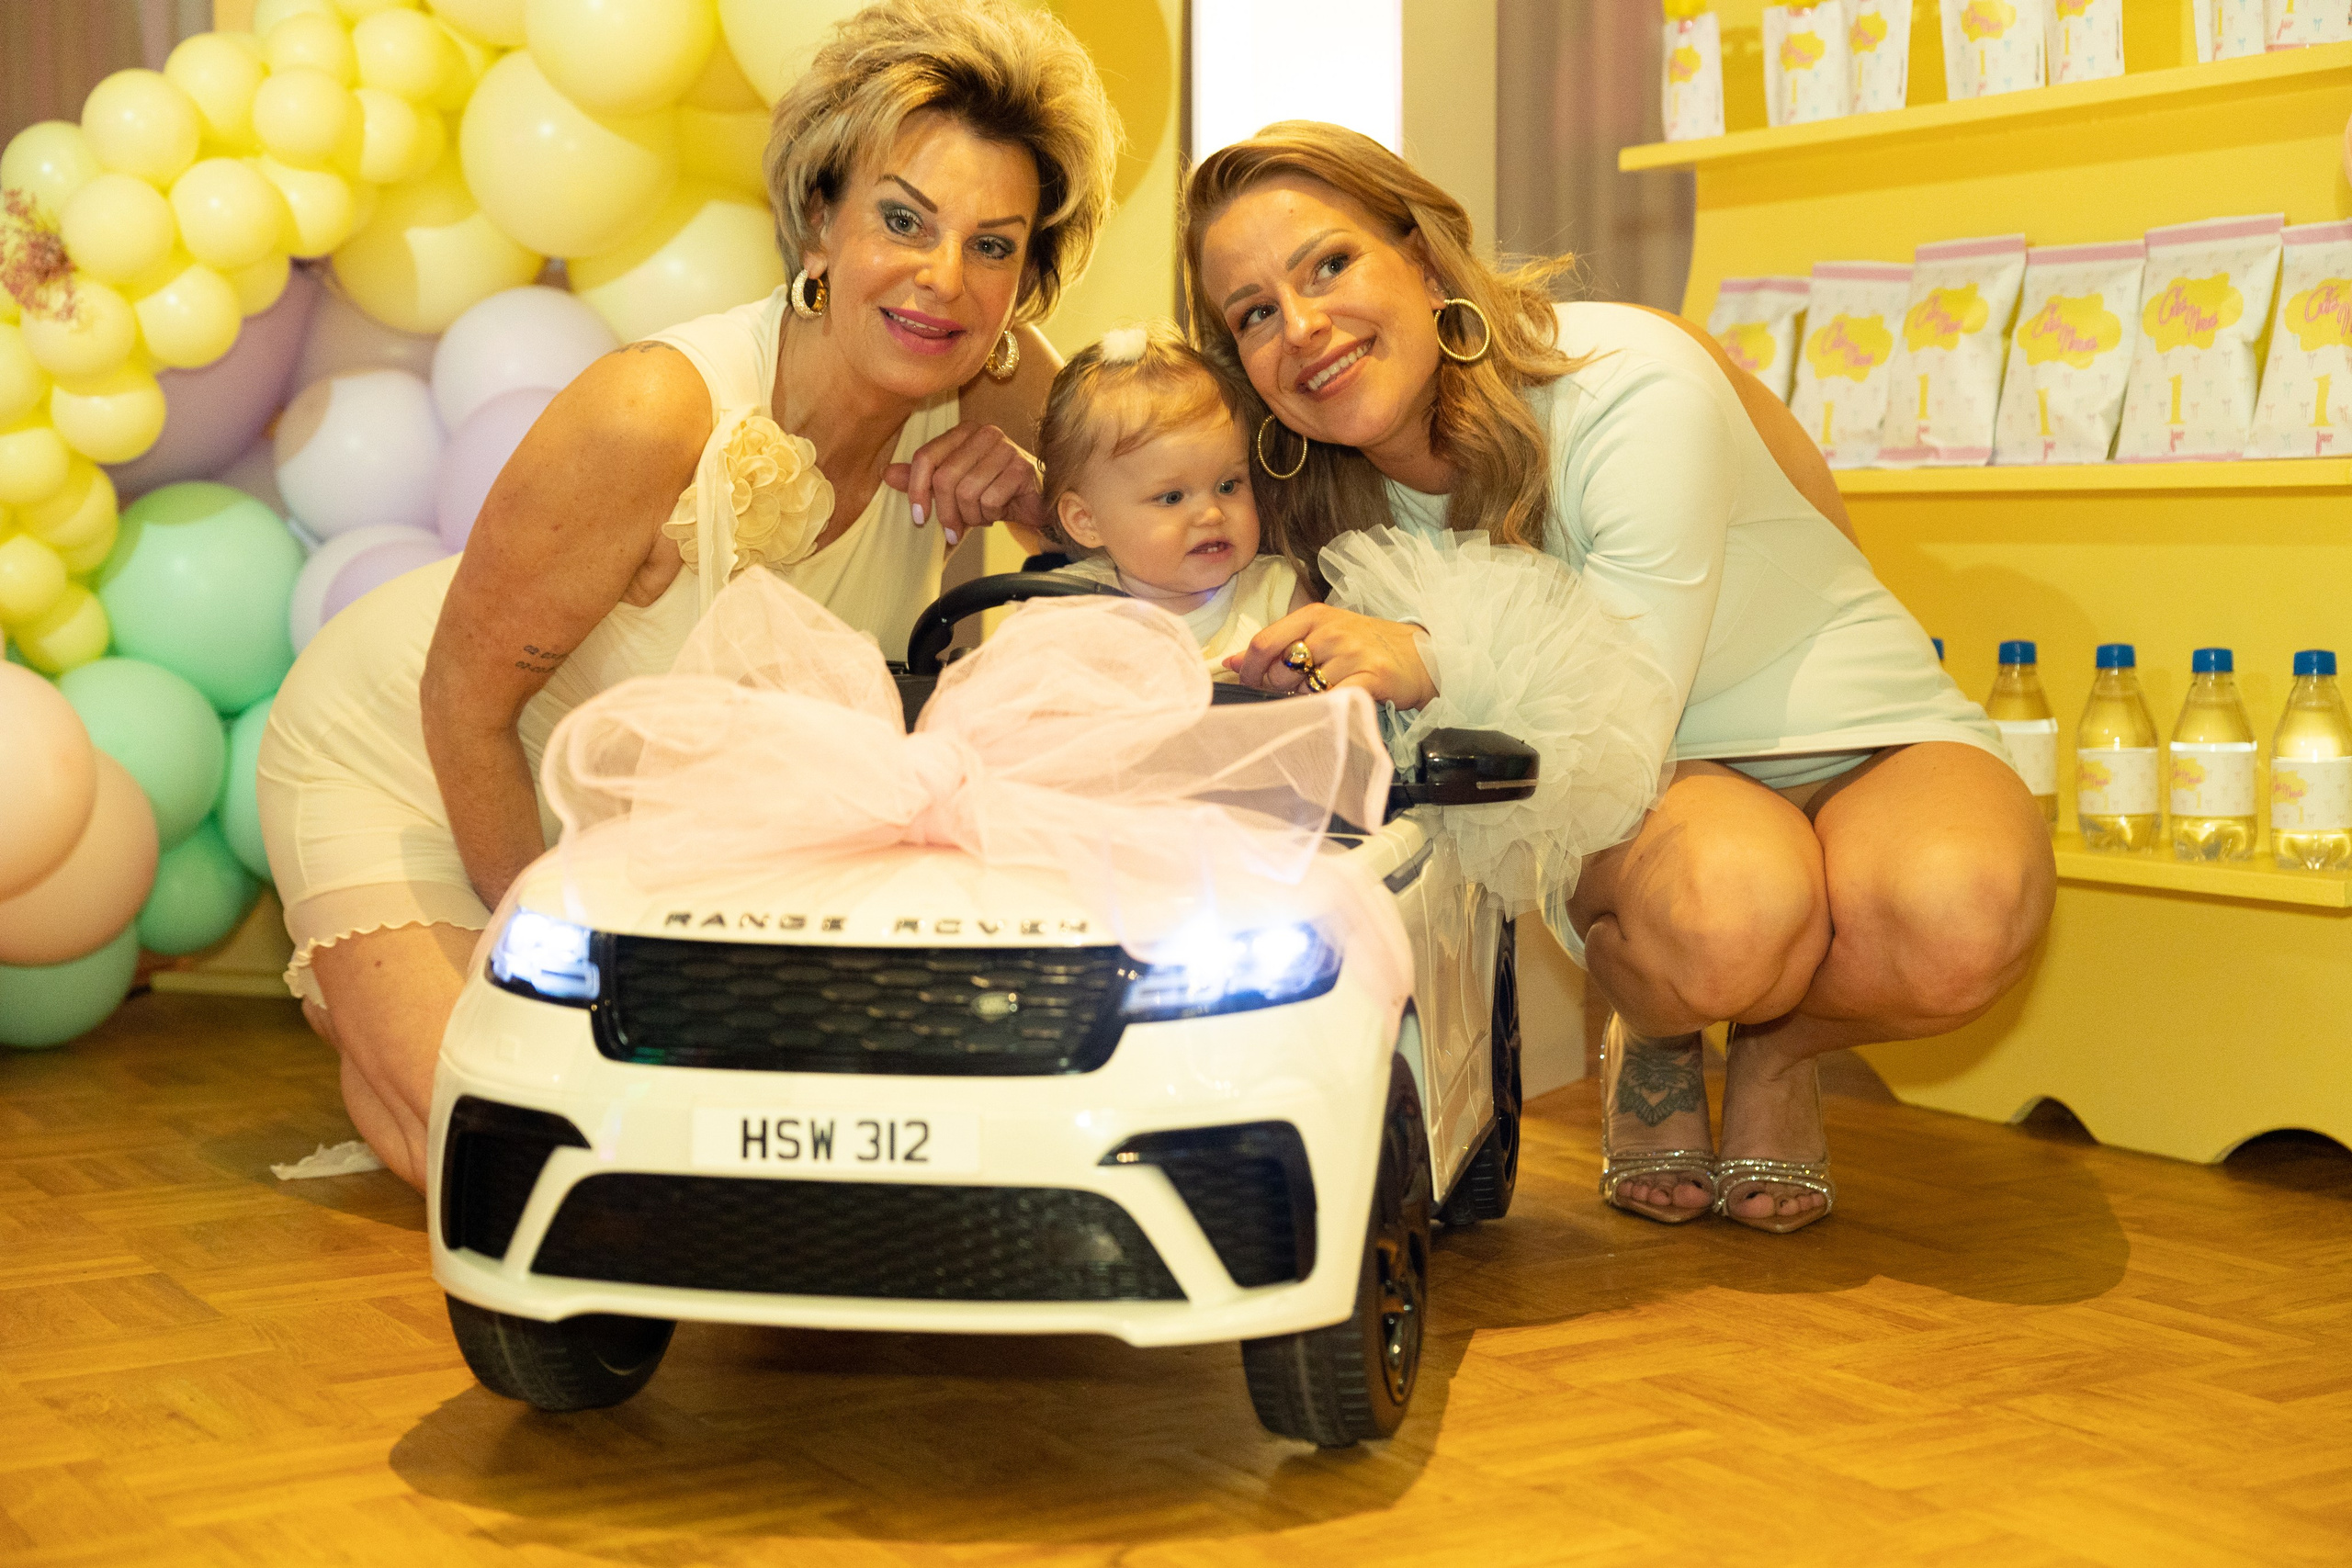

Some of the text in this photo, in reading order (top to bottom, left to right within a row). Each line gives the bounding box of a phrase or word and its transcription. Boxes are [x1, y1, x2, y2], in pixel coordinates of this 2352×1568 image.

[2165, 374, 2186, 425] 1
[2309, 373, 2334, 427] 1
[664, 912, 847, 932] RANGE
[741, 1117, 929, 1161] HSW 312
